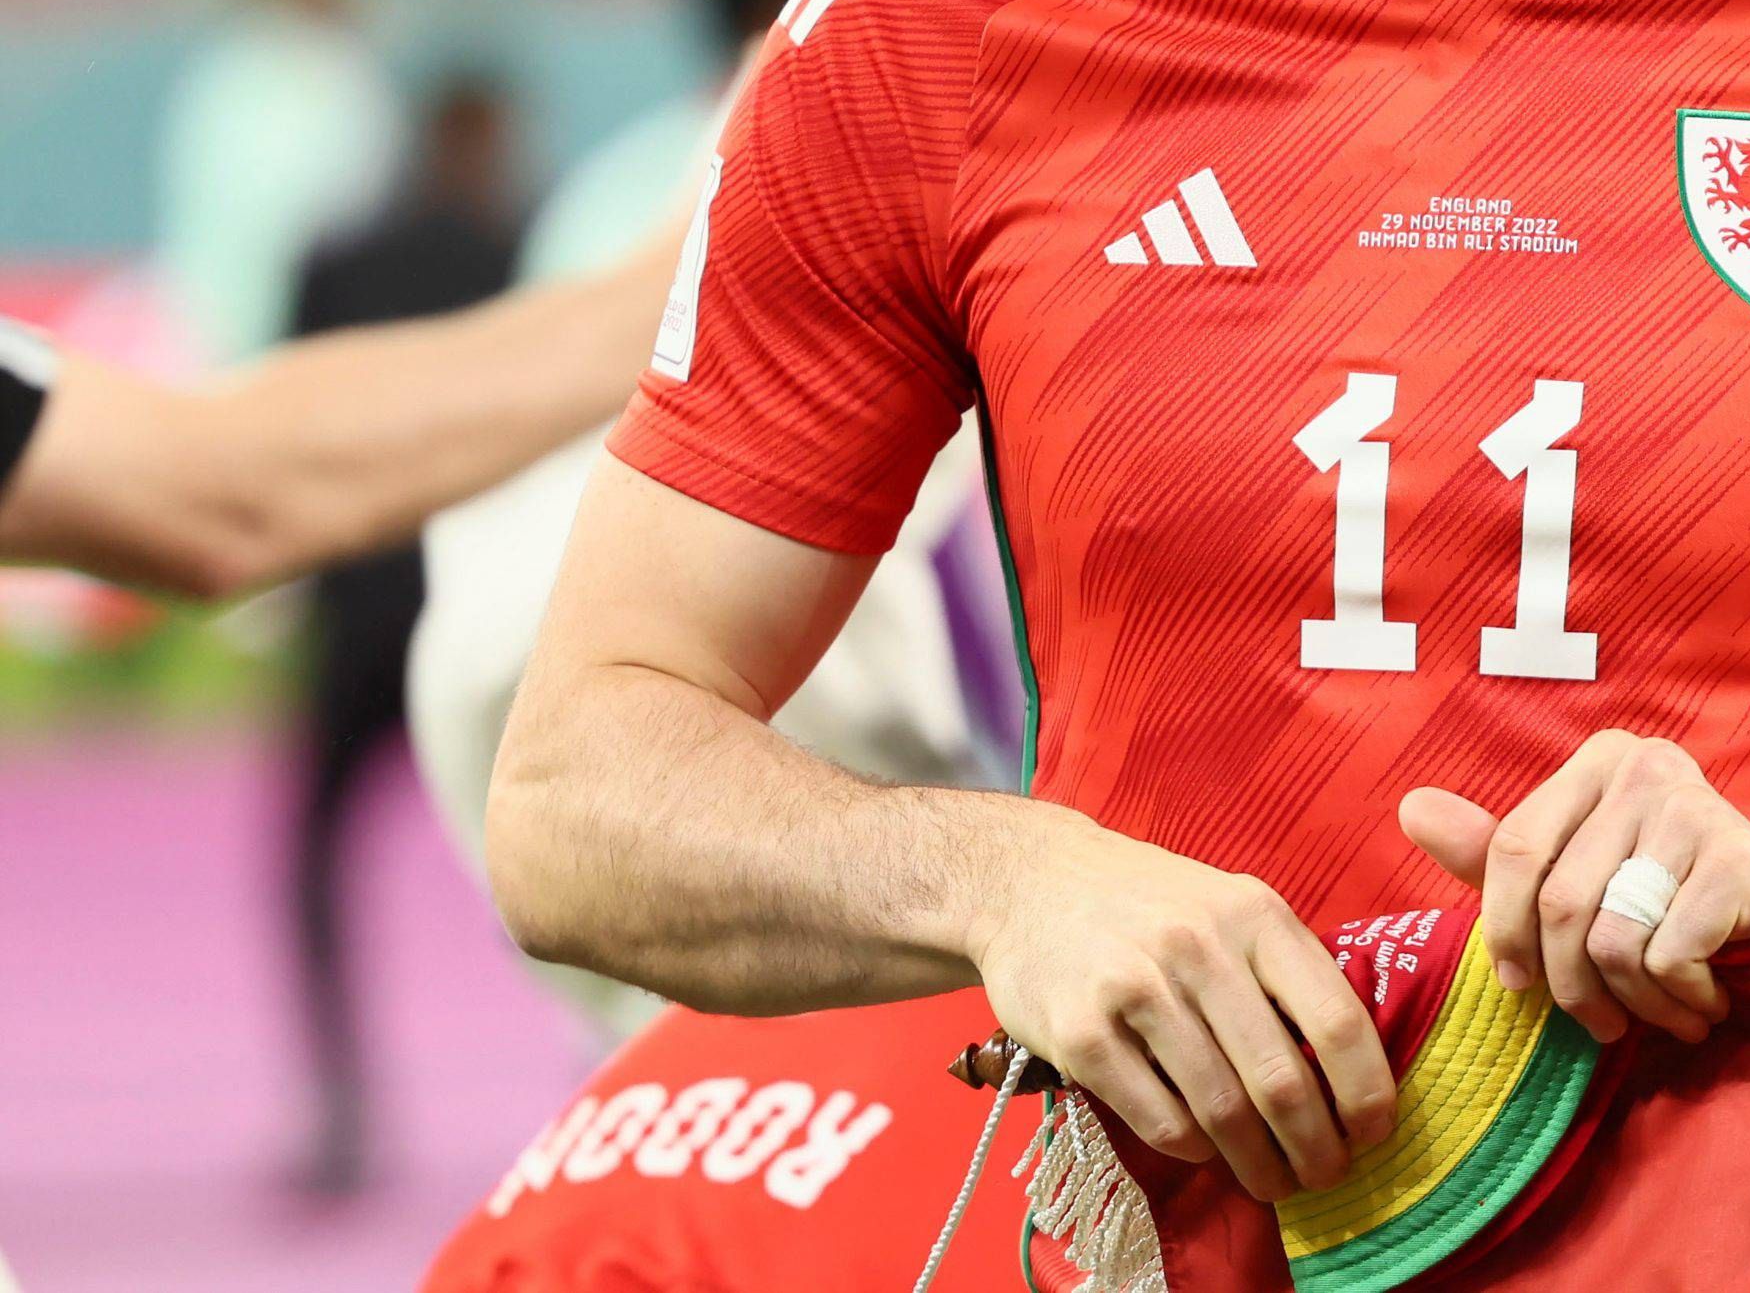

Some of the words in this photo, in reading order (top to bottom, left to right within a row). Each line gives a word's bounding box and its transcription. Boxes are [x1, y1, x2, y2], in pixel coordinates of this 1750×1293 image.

[1429, 197, 1513, 215] ENGLAND
[1381, 213, 1404, 230] 29
[1410, 215, 1506, 233] NOVEMBER
[1512, 218, 1559, 235] 2022
[1358, 231, 1420, 248] AHMAD
[1426, 234, 1457, 249] BIN
[1464, 234, 1493, 251] ALI
[1500, 236, 1578, 254] STADIUM
[1291, 371, 1599, 681] 11
[1336, 934, 1353, 945] B
[1395, 953, 1418, 973] 29
[487, 1077, 894, 1218] RODON
